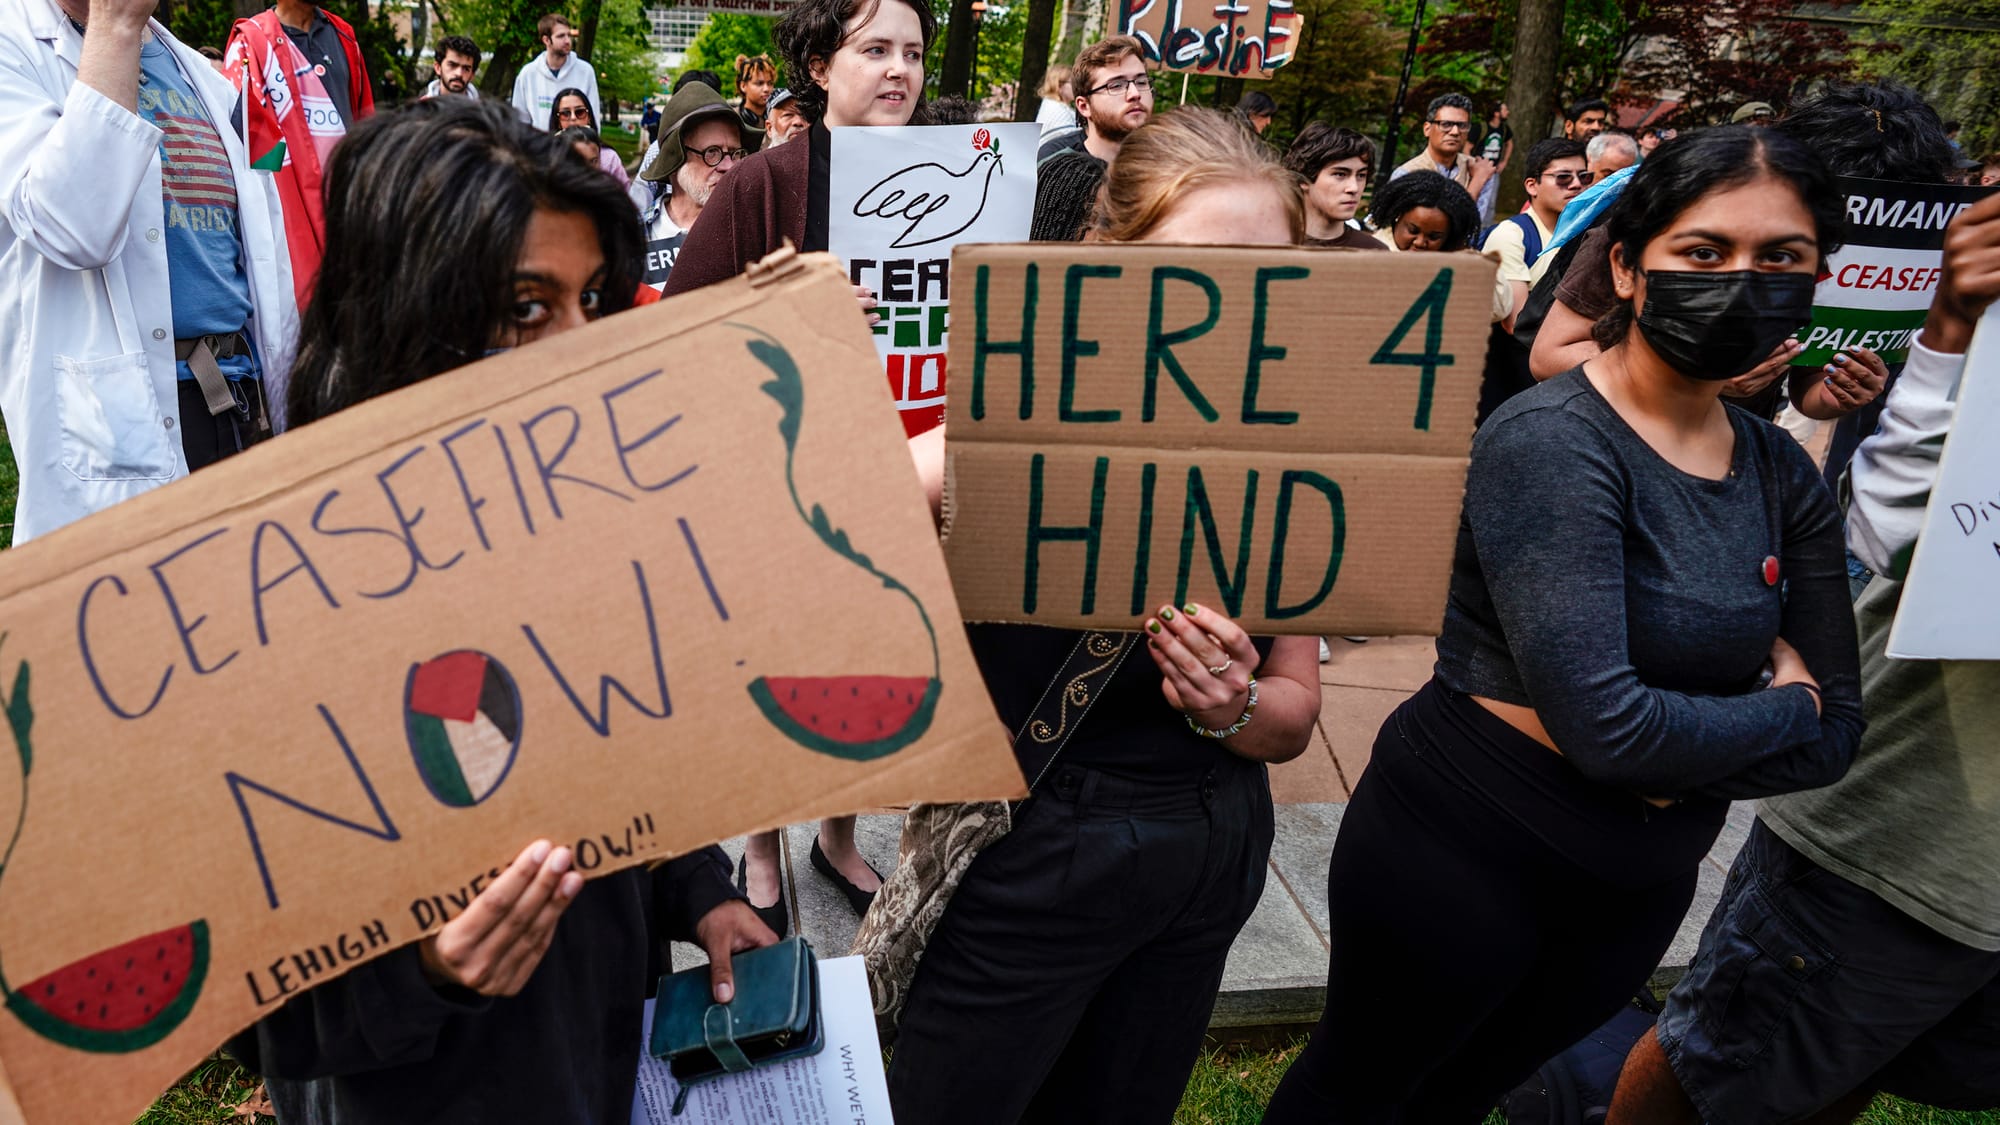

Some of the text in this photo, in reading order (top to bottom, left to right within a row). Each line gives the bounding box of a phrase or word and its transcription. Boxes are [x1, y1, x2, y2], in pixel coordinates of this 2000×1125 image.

[1837, 264, 1942, 291] CEASEF
[1842, 195, 1972, 231] RMAN
[970, 262, 1454, 432] HERE 4
[77, 369, 699, 720] CEASEFIRE
[1022, 452, 1347, 619] HIND
[225, 516, 746, 910] NOW!
[244, 919, 390, 1007] LEHIGH
[566, 812, 659, 872] OW!!
[760, 1081, 774, 1118] DISCLOSE
[840, 1044, 857, 1082] WHY
